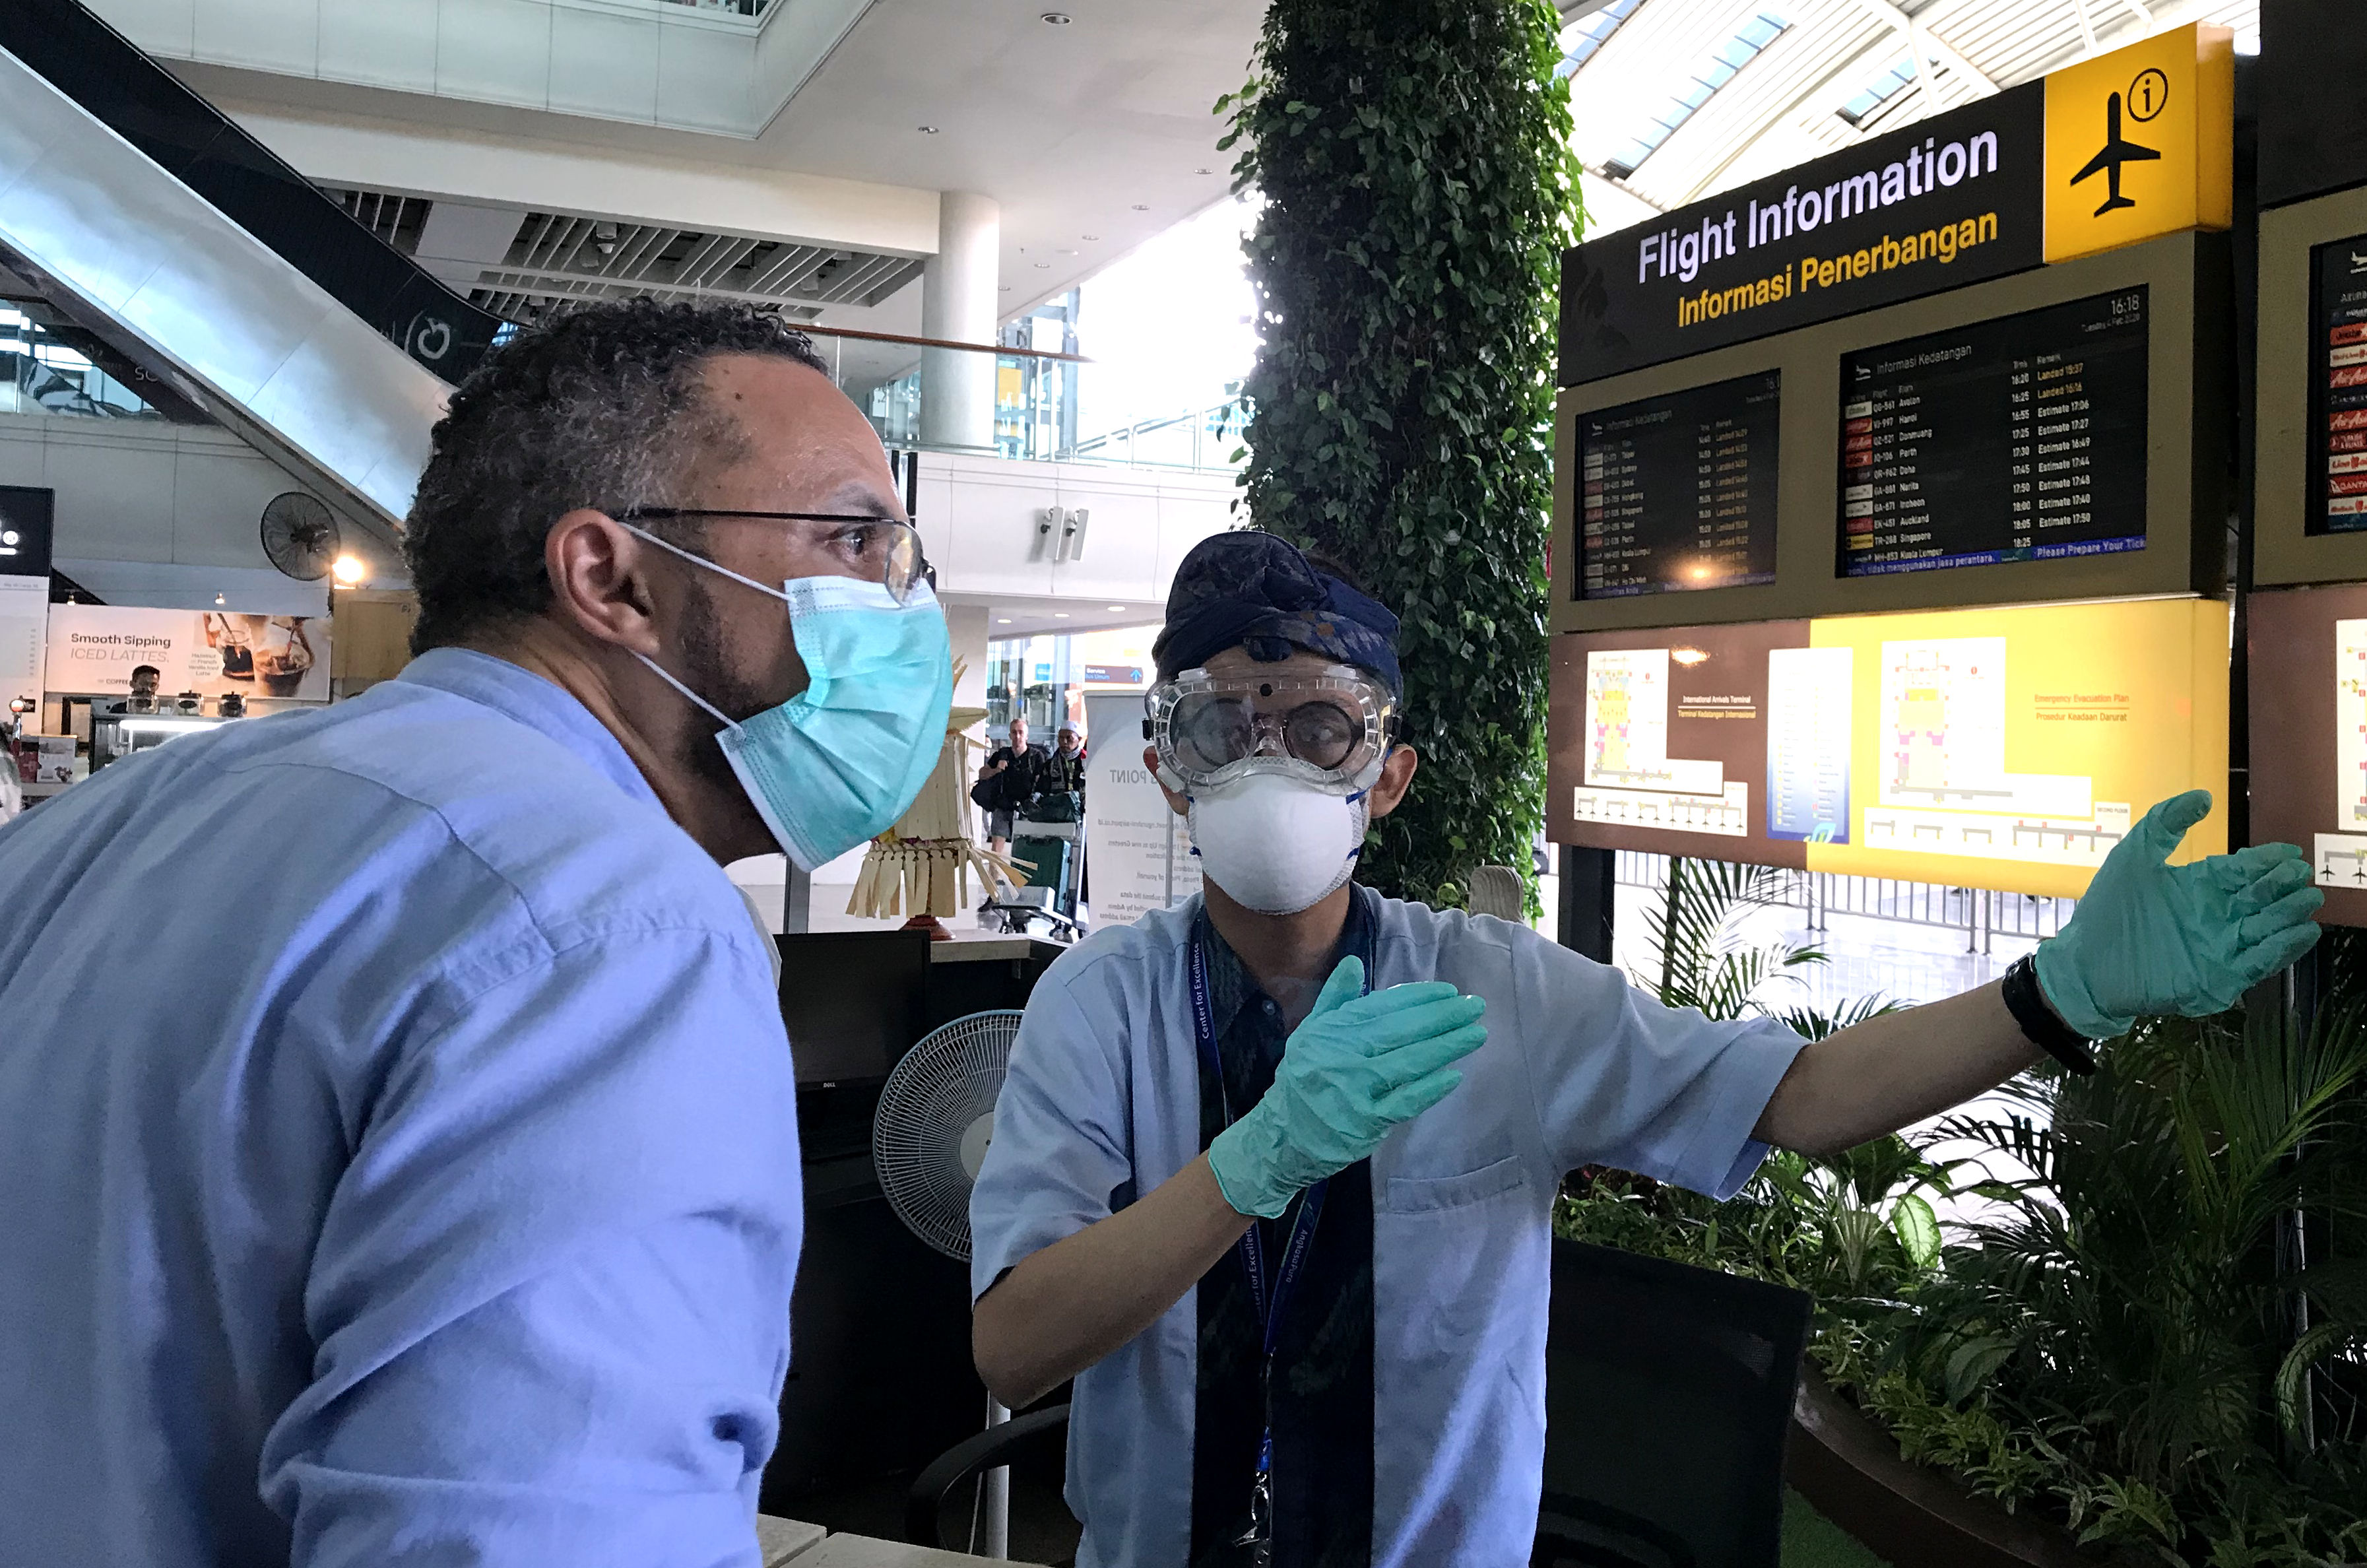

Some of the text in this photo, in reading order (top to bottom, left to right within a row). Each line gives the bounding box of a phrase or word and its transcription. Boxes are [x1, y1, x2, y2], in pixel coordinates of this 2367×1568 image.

[1638, 131, 1998, 284] Flight Information
[1678, 212, 1998, 327] Informasi Penerbangan
[2111, 294, 2139, 315] 16:18
[1877, 345, 1972, 375] Informasi Kedatangan
[2038, 403, 2069, 418] Estimate
[2038, 422, 2070, 436] Estimate
[2071, 418, 2089, 430] 17:27
[2038, 441, 2070, 454] Estimate
[2038, 459, 2071, 473] Estimate
[2038, 478, 2071, 491] Estimate
[2039, 496, 2071, 509] Estimate
[2039, 515, 2071, 528] Estimate
[2037, 547, 2065, 558] Please
[2067, 543, 2100, 556] Prepare
[2103, 540, 2124, 550] Your
[71, 633, 171, 649] Smooth Sipping
[71, 648, 170, 663] ICED LATTES.
[1730, 695, 1751, 703] Terminal
[2034, 694, 2129, 704] Emergency Evacuation Plan
[2100, 713, 2127, 721] Darurat
[1193, 943, 1202, 990] Excellence
[1198, 1007, 1210, 1039] Center
